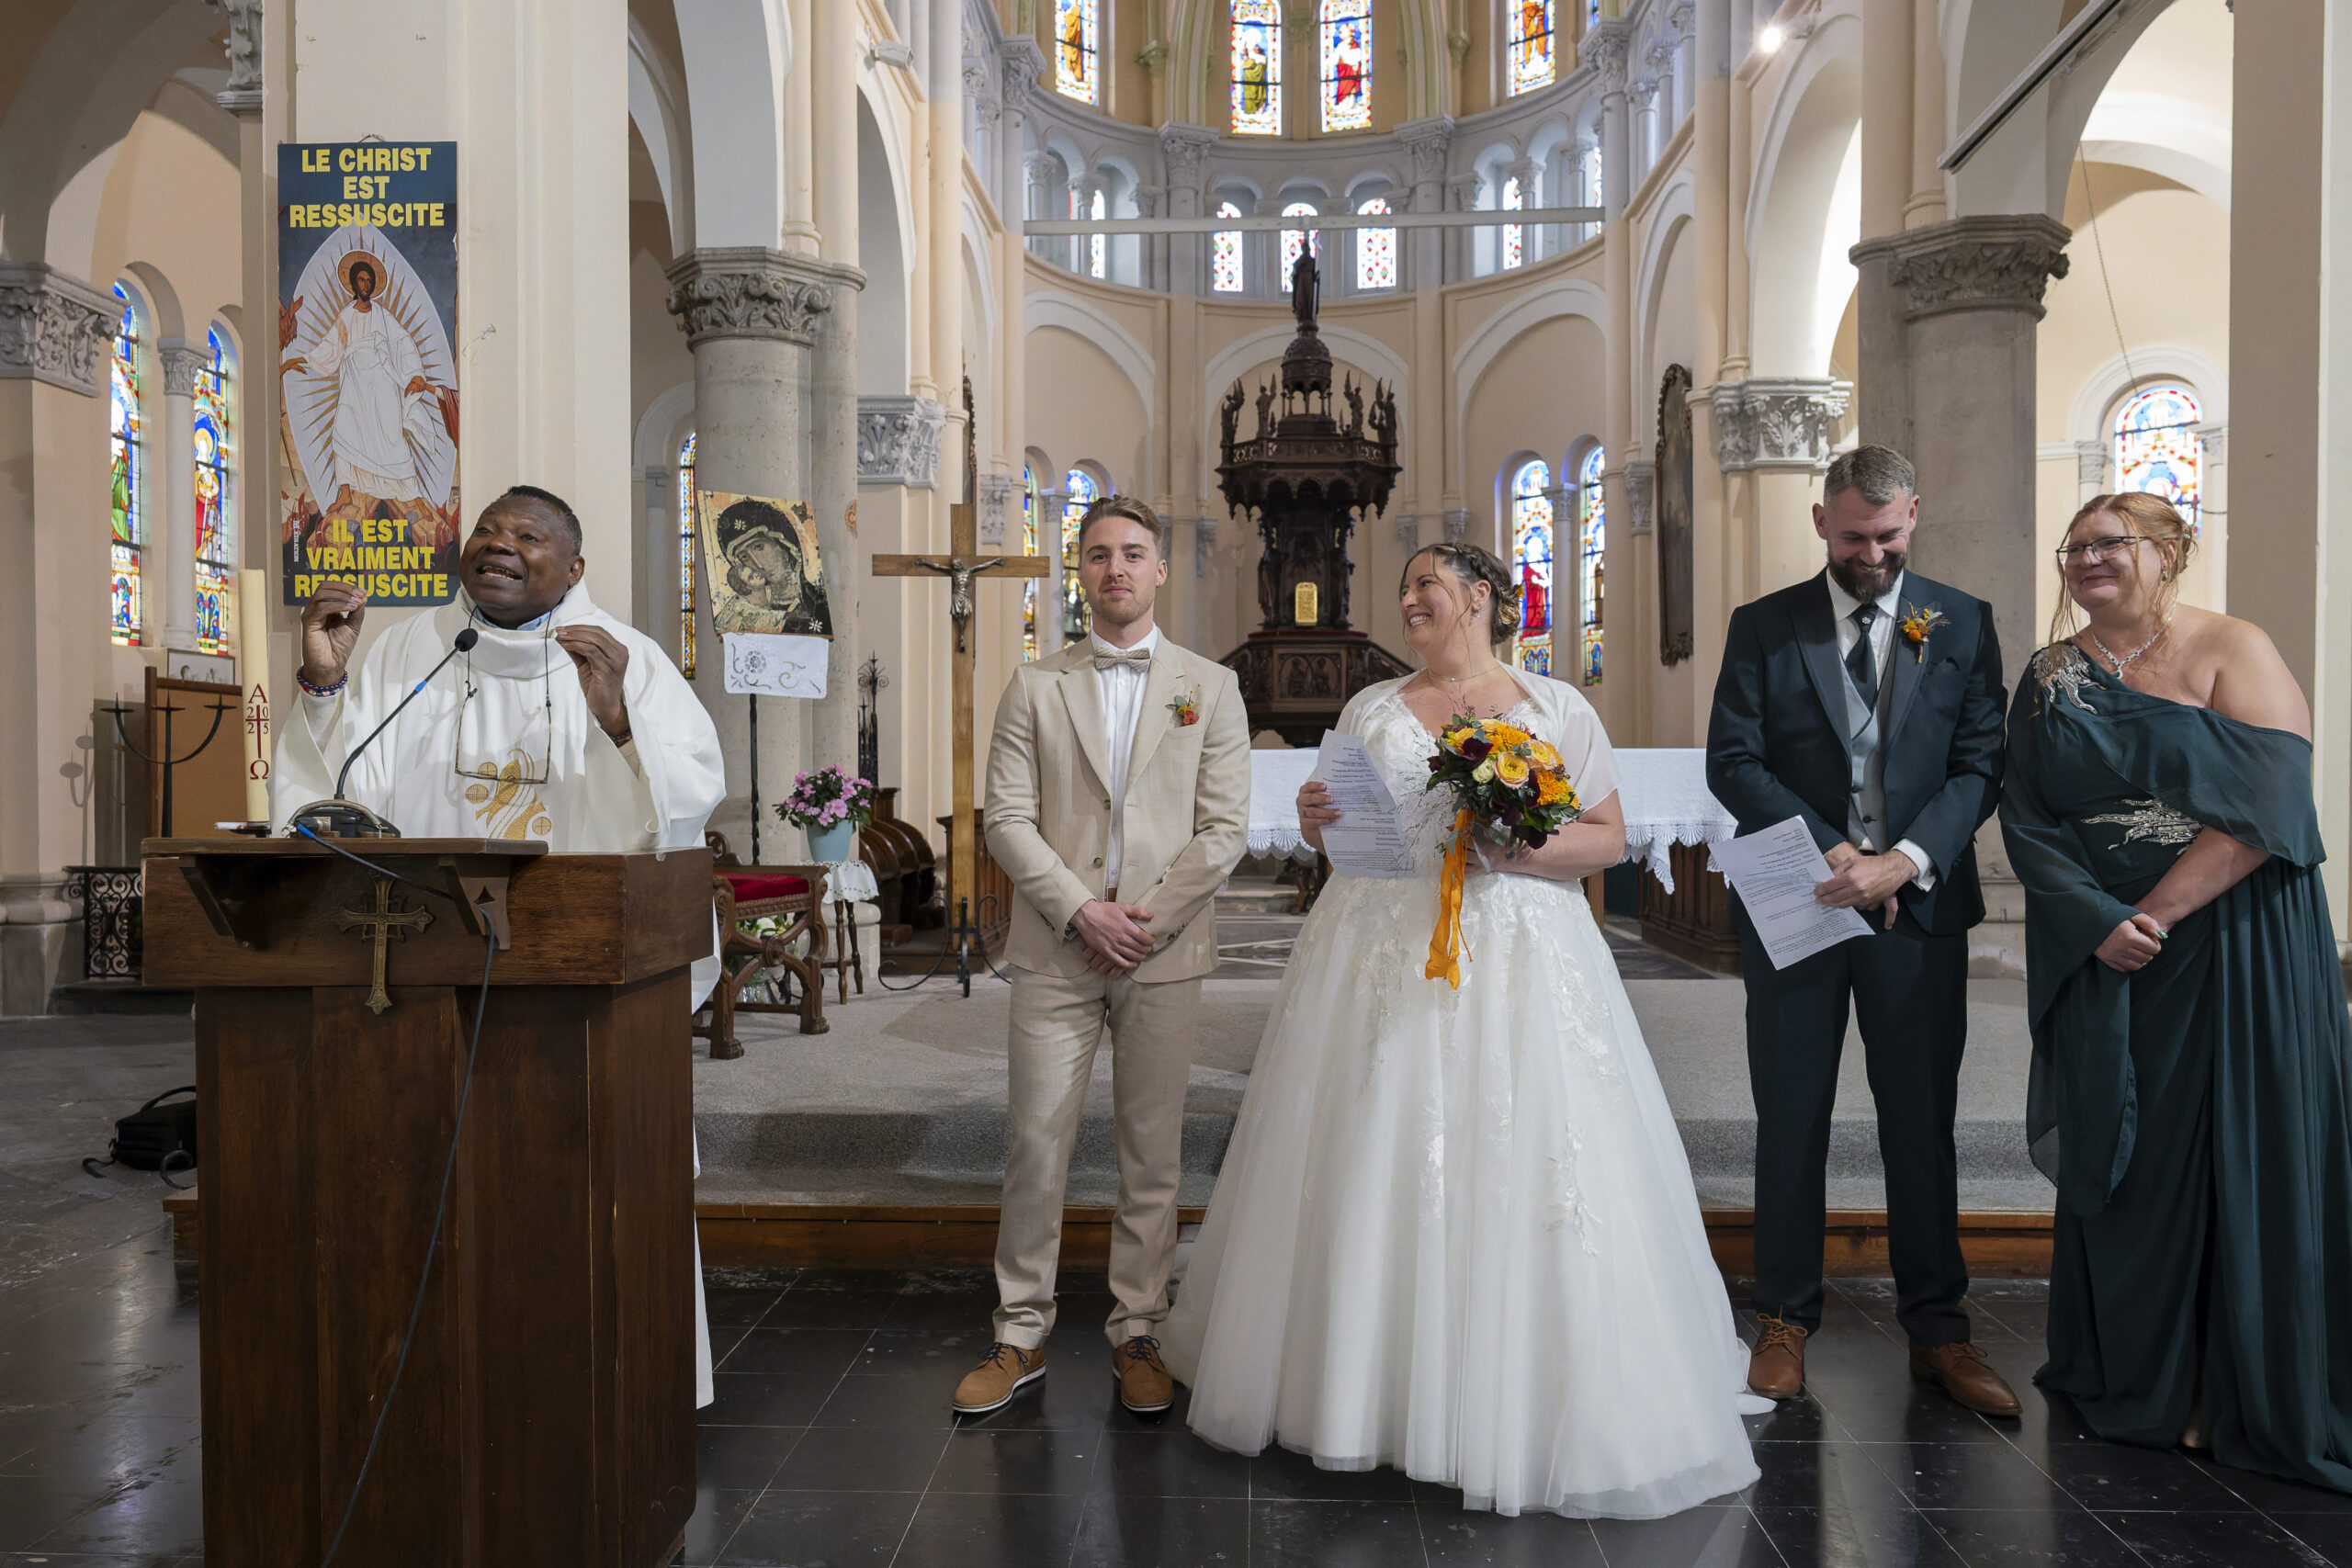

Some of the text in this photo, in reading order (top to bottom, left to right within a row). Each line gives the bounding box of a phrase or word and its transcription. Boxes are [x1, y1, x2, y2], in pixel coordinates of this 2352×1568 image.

[301, 147, 432, 173] LE CHRIST
[343, 175, 390, 200] EST
[289, 202, 445, 229] RESSUSCITE
[333, 518, 409, 543] IL EST
[306, 546, 435, 570] VRAIMENT
[248, 683, 267, 704] A
